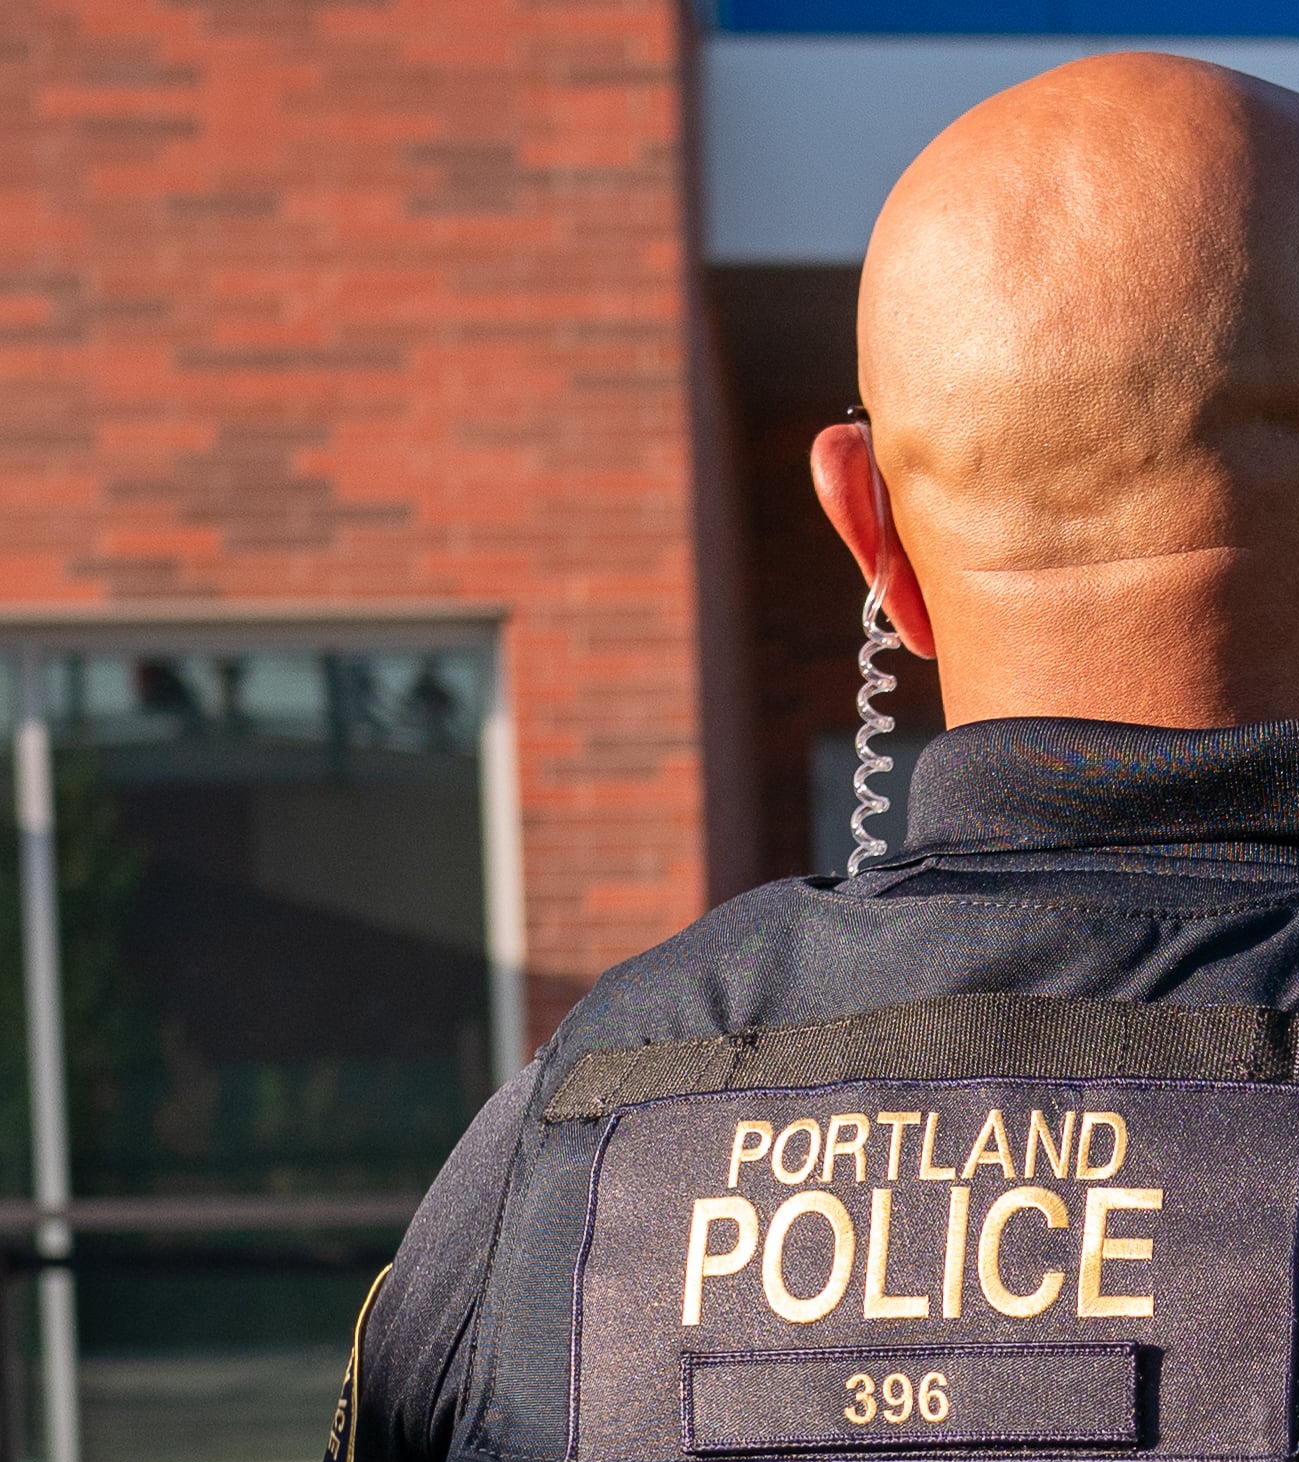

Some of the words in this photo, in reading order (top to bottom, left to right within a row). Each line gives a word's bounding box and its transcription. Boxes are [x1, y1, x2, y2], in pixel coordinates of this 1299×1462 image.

[727, 1110, 1129, 1188] PORTLAND
[681, 1187, 1164, 1326] POLICE
[843, 1372, 951, 1424] 396
